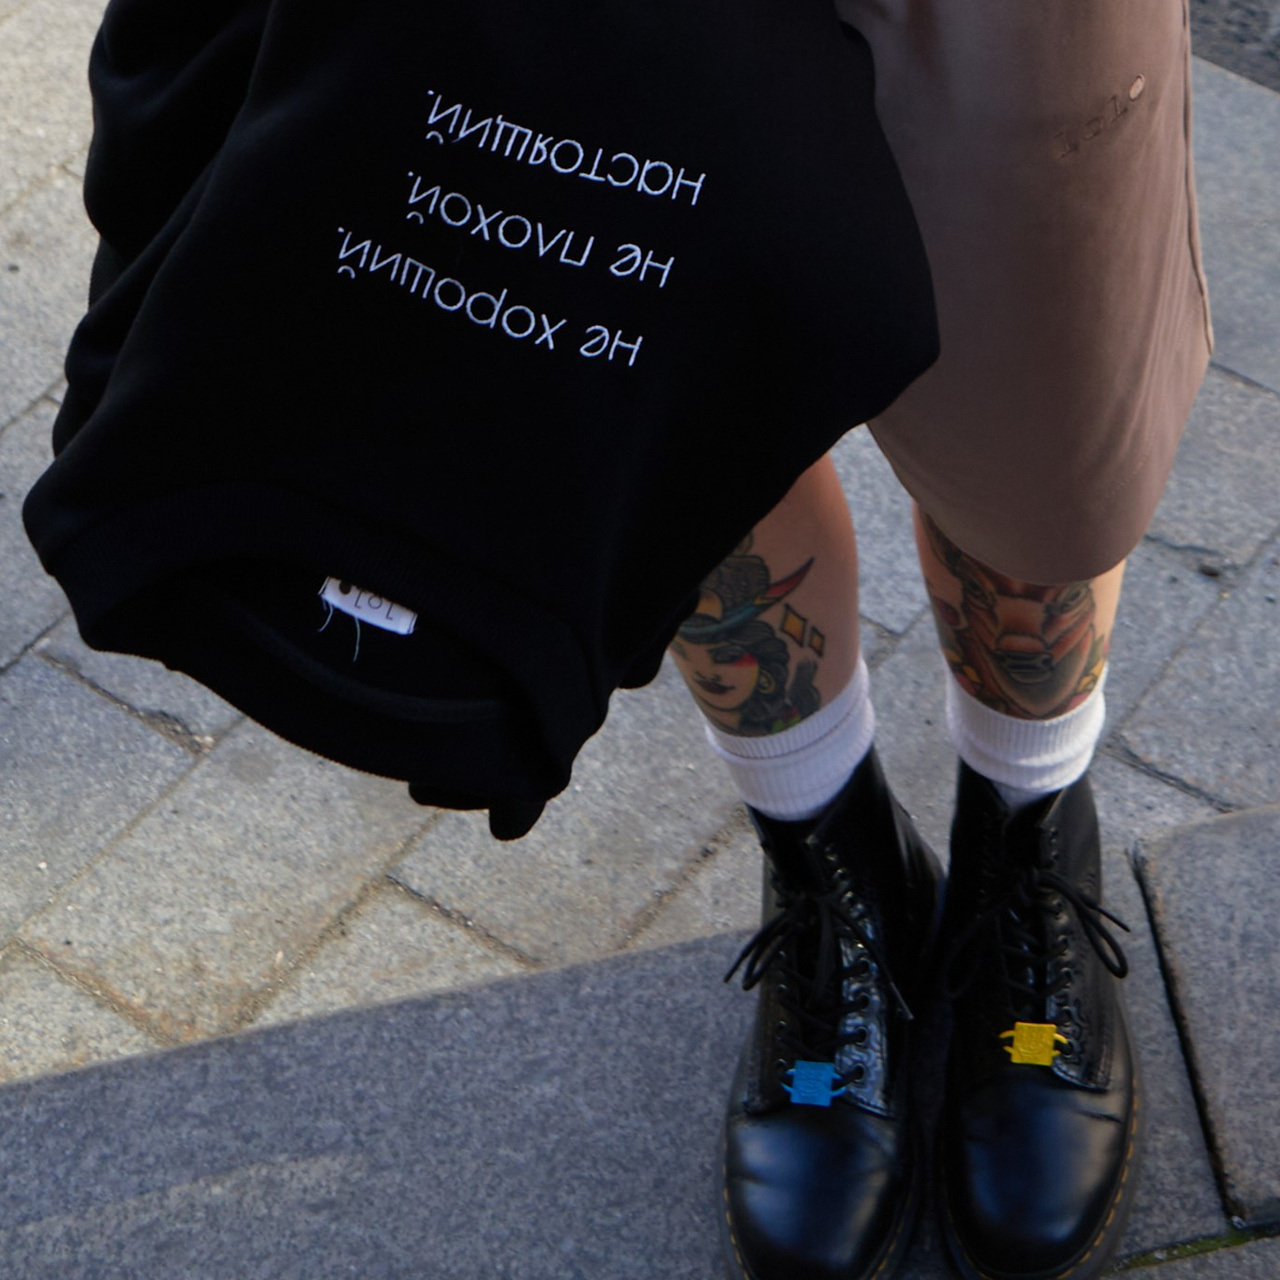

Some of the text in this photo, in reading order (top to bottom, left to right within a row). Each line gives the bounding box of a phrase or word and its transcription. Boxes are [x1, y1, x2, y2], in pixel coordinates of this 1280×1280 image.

[426, 90, 706, 205] настоящий.
[407, 172, 674, 288] не плохой.
[338, 227, 643, 366] не хороший.
